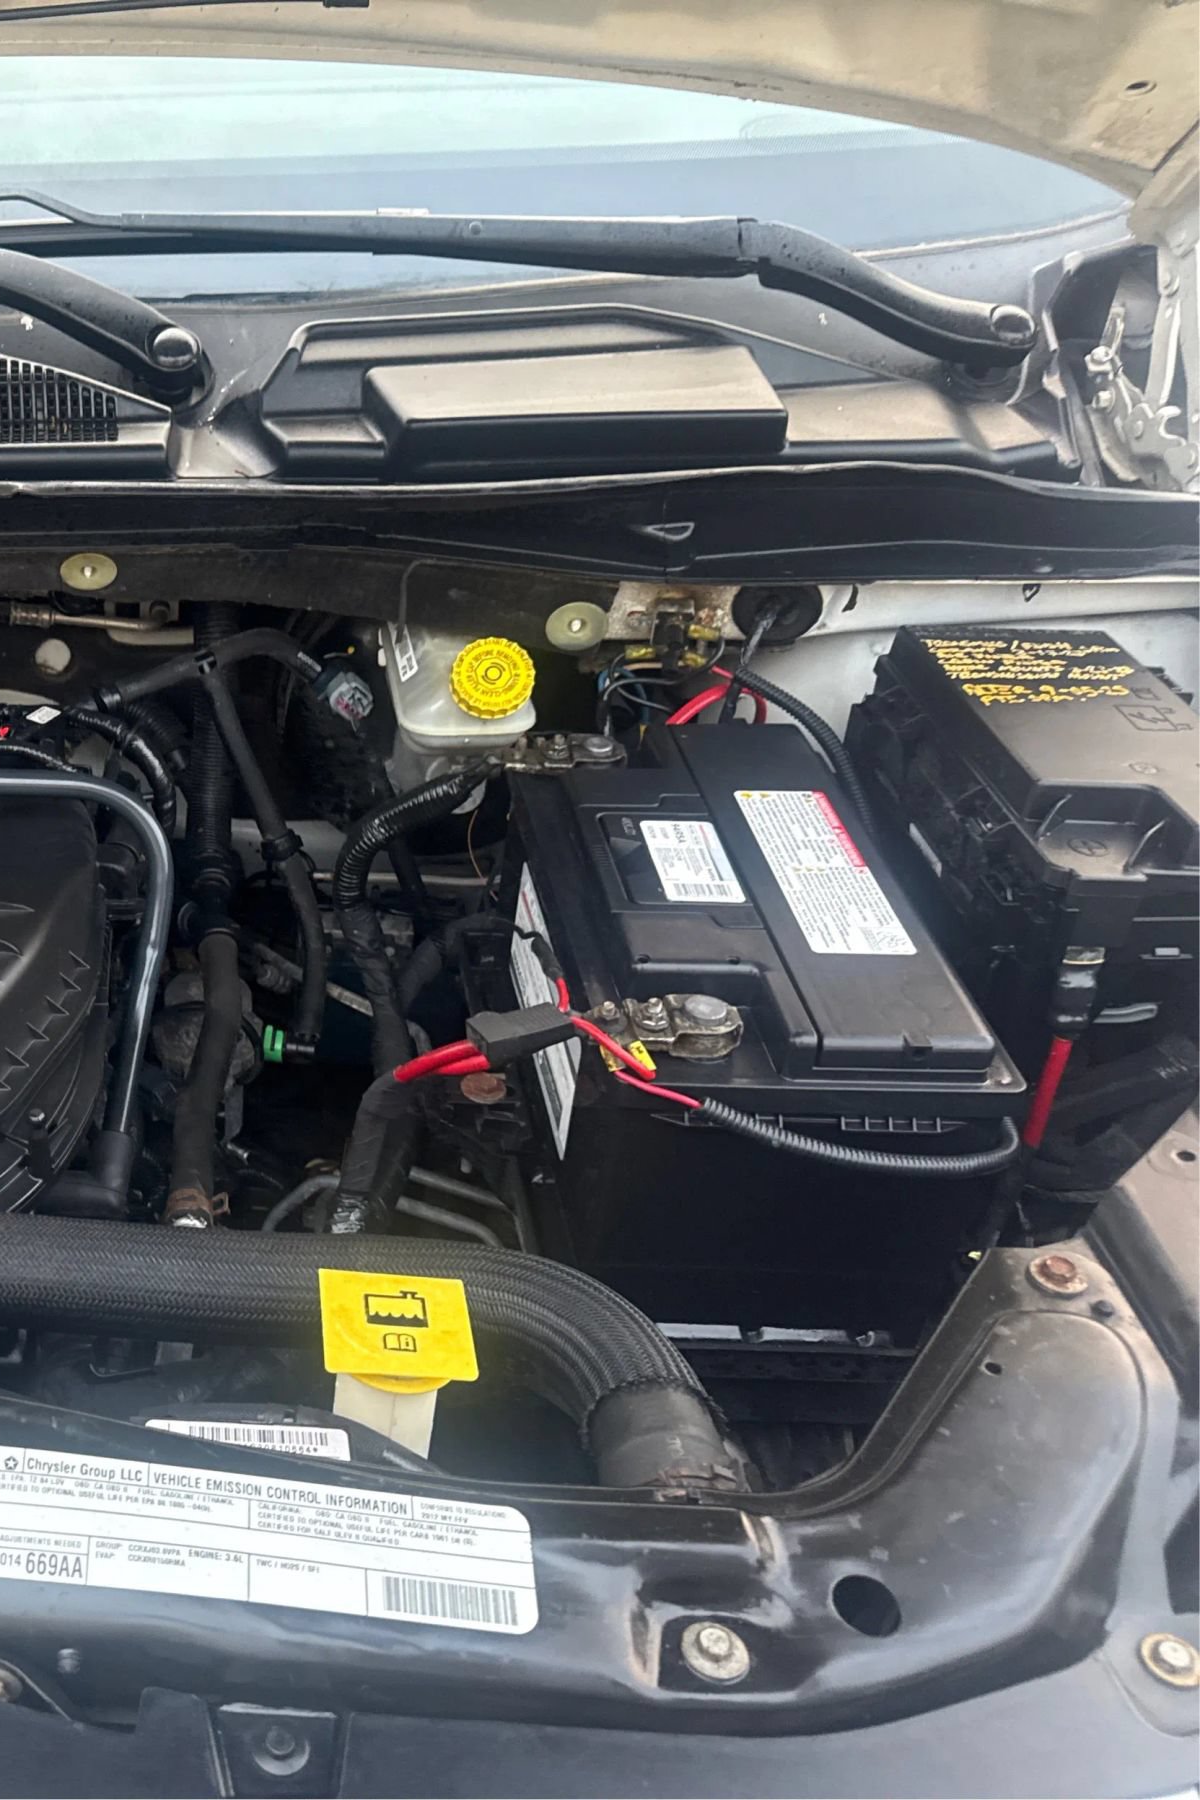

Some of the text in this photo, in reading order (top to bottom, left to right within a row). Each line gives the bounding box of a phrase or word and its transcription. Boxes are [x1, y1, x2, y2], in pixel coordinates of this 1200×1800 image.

[26, 1457, 142, 1482] Chrysler Group LLC
[153, 1472, 407, 1515] VEHICLE EMISSION CONTROL INFORMATION
[24, 1551, 84, 1578] 669AA
[188, 1549, 243, 1563] ENGINE: 3.6L
